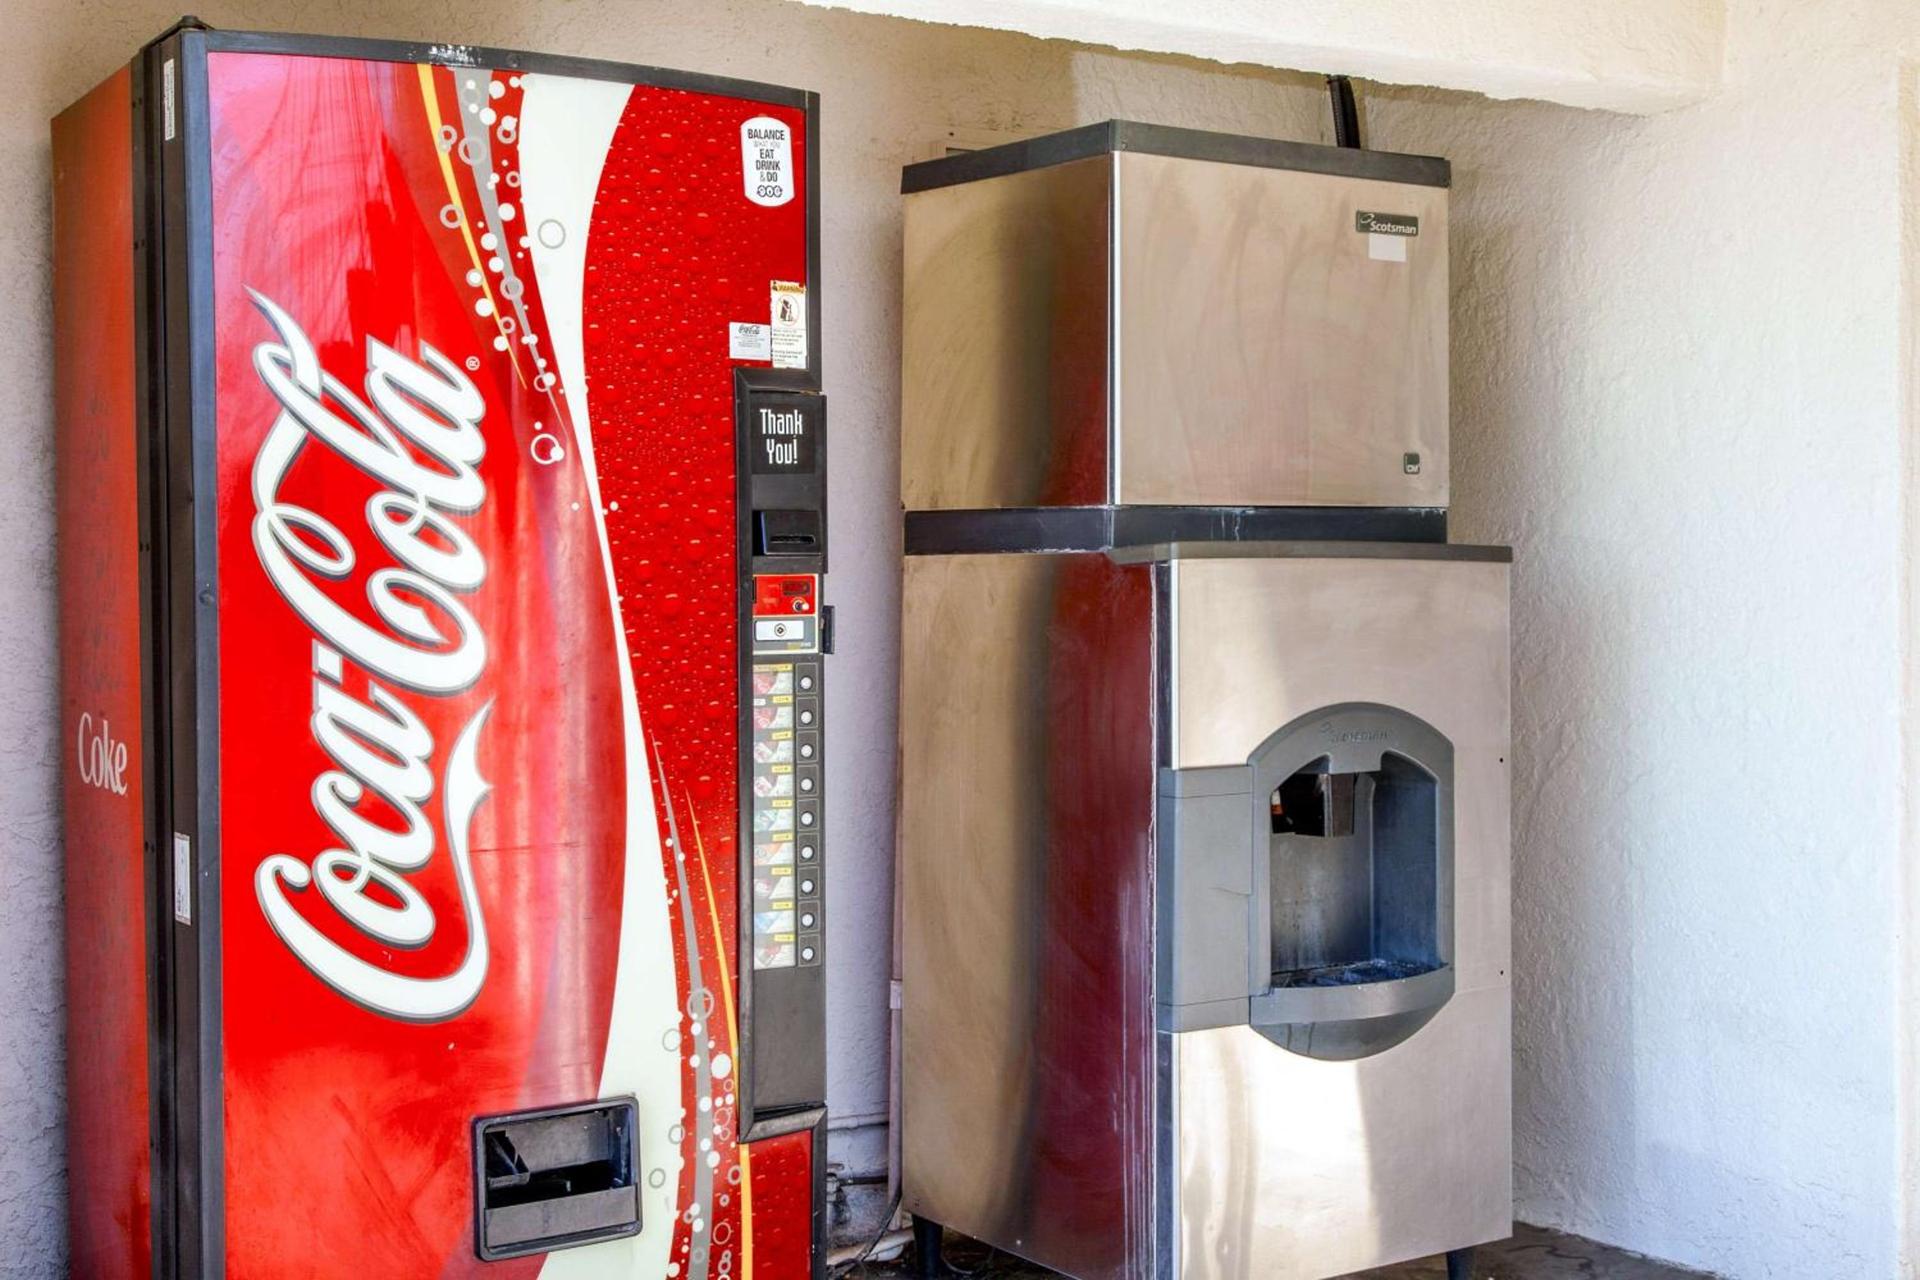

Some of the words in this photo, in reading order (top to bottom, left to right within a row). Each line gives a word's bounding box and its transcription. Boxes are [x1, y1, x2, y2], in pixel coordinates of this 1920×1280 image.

[747, 128, 785, 140] BALANCE
[759, 148, 774, 159] EAT
[755, 159, 781, 171] DRINK
[766, 171, 778, 182] DO
[1369, 220, 1417, 235] Scotsman
[759, 408, 803, 435] Thank
[766, 438, 798, 464] You!
[243, 284, 496, 1024] Coca-Cola
[78, 712, 128, 796] Coke
